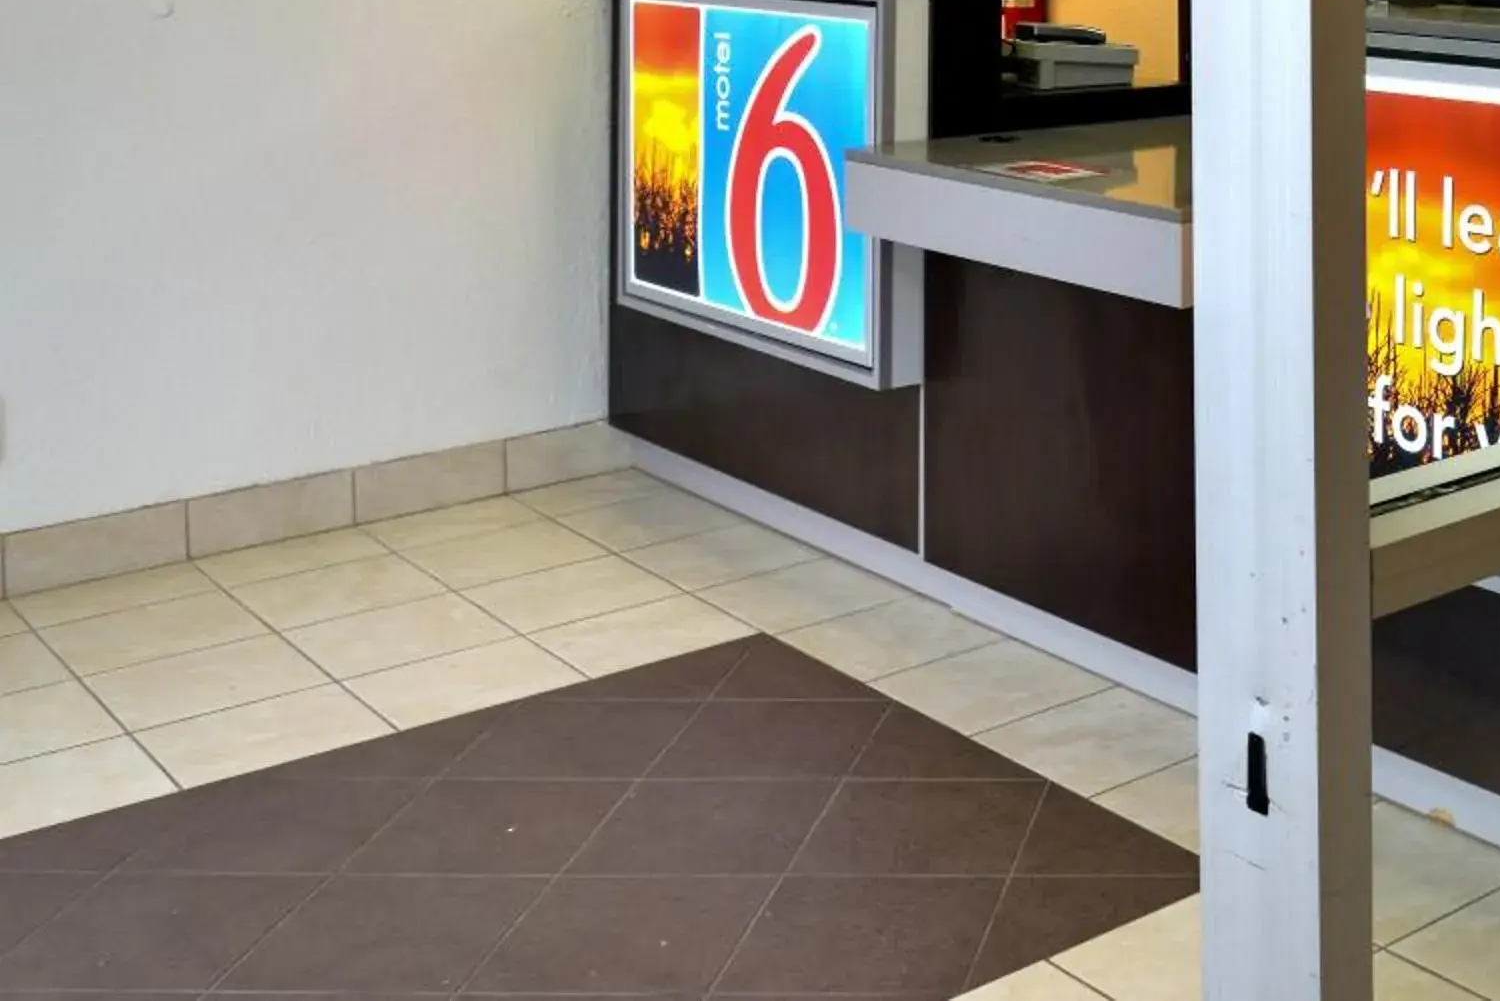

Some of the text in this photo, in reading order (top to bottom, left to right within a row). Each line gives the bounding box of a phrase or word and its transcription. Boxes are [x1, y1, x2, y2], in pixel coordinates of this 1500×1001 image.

[714, 24, 843, 336] motel 6
[1371, 168, 1416, 242] 'll
[1368, 373, 1456, 459] for
